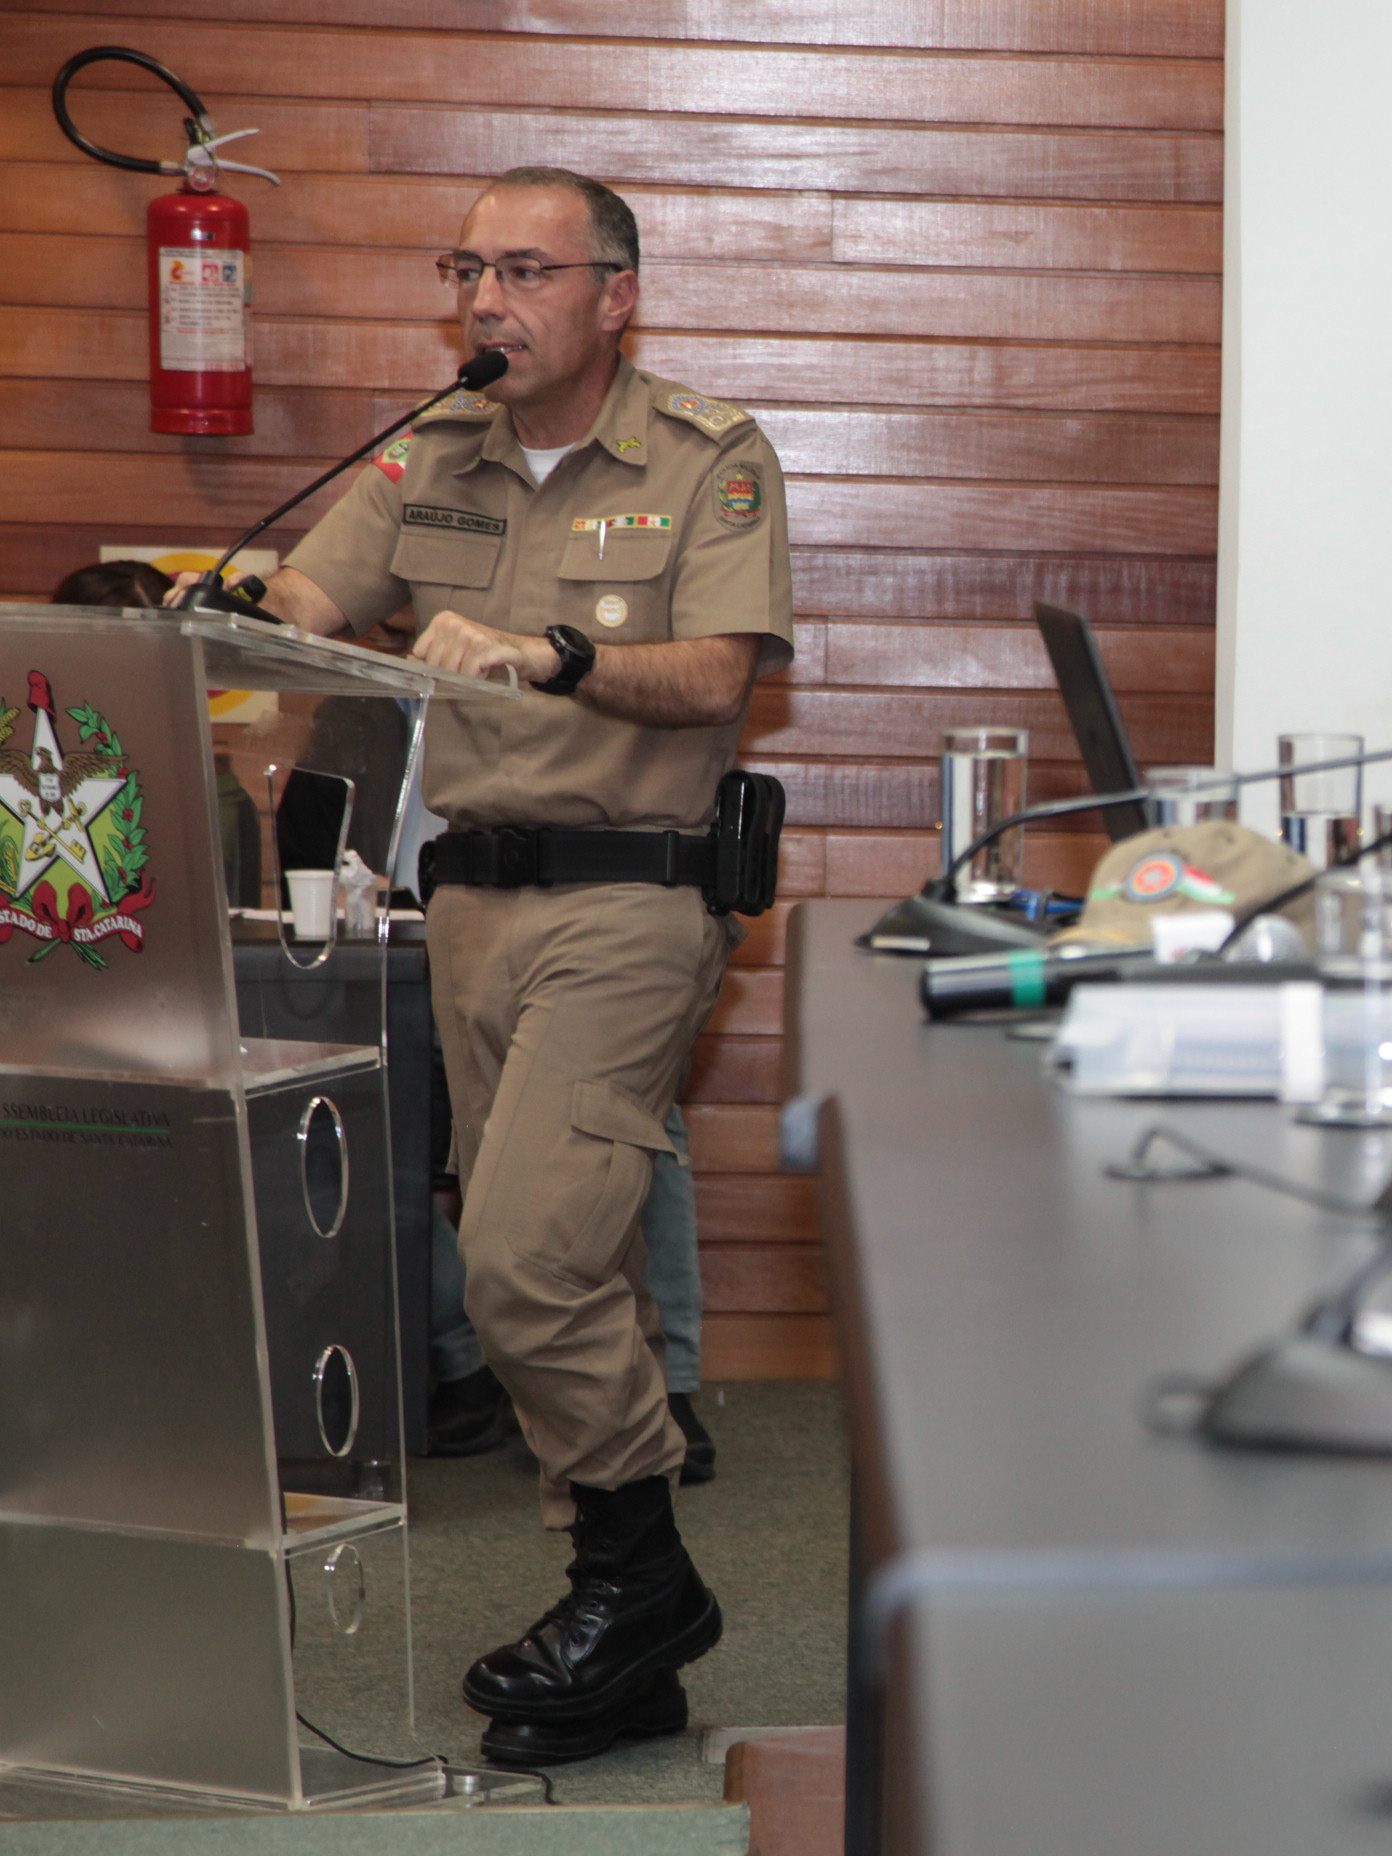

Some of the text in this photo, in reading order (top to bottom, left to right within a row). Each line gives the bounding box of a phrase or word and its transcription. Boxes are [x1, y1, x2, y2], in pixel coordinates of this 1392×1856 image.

[408, 509, 501, 531] ARAÚJO GOMES
[0, 909, 36, 932] STADO
[36, 923, 53, 938] DE
[2, 1102, 170, 1127] SSEMBLEIA LEGISLATIVA
